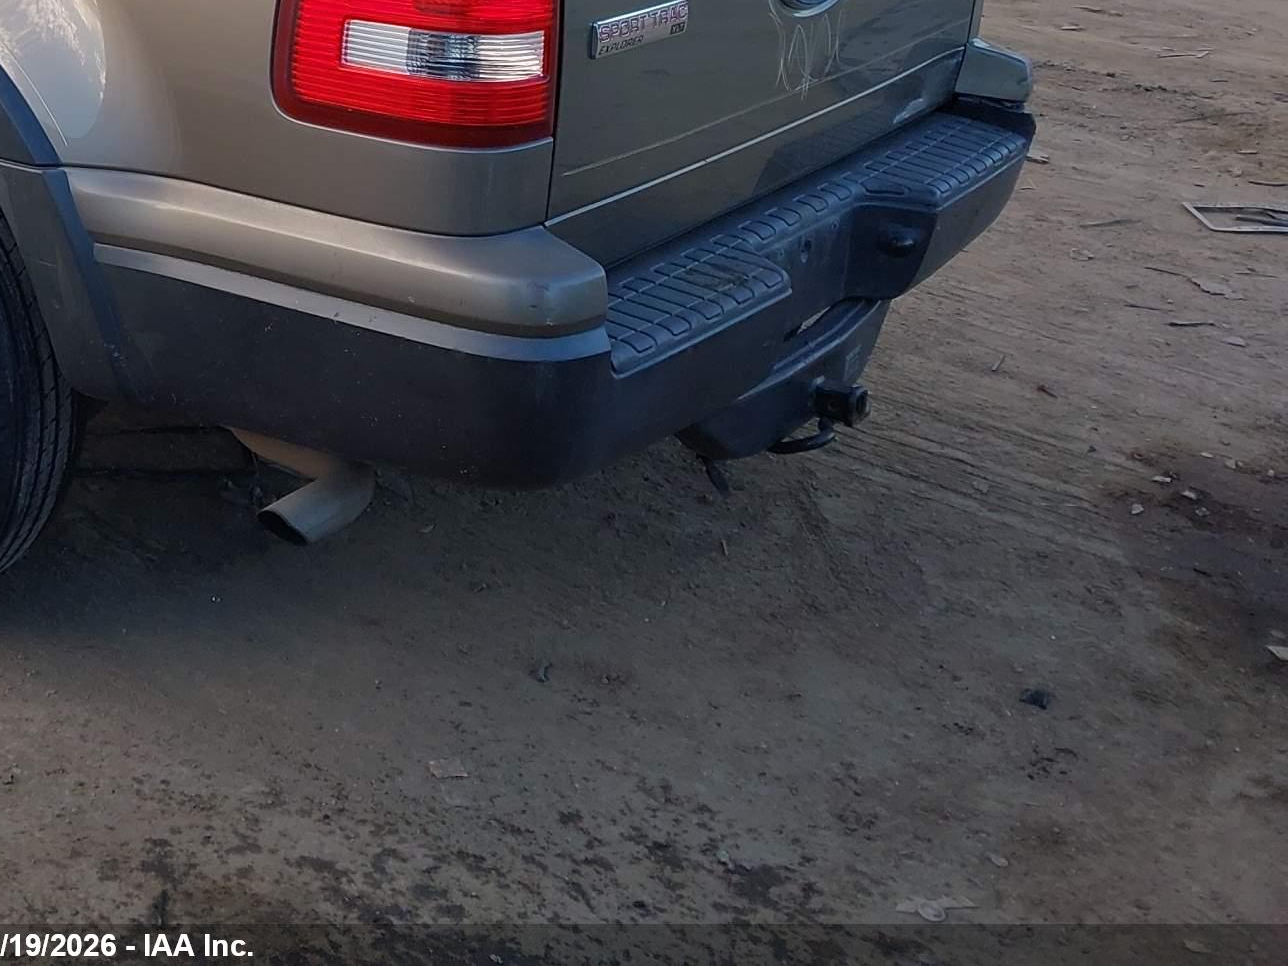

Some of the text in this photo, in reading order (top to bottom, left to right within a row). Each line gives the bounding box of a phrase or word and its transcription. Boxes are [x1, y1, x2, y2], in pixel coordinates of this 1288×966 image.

[598, 1, 689, 43] SPORT TRAC
[598, 35, 644, 55] EXPLORER
